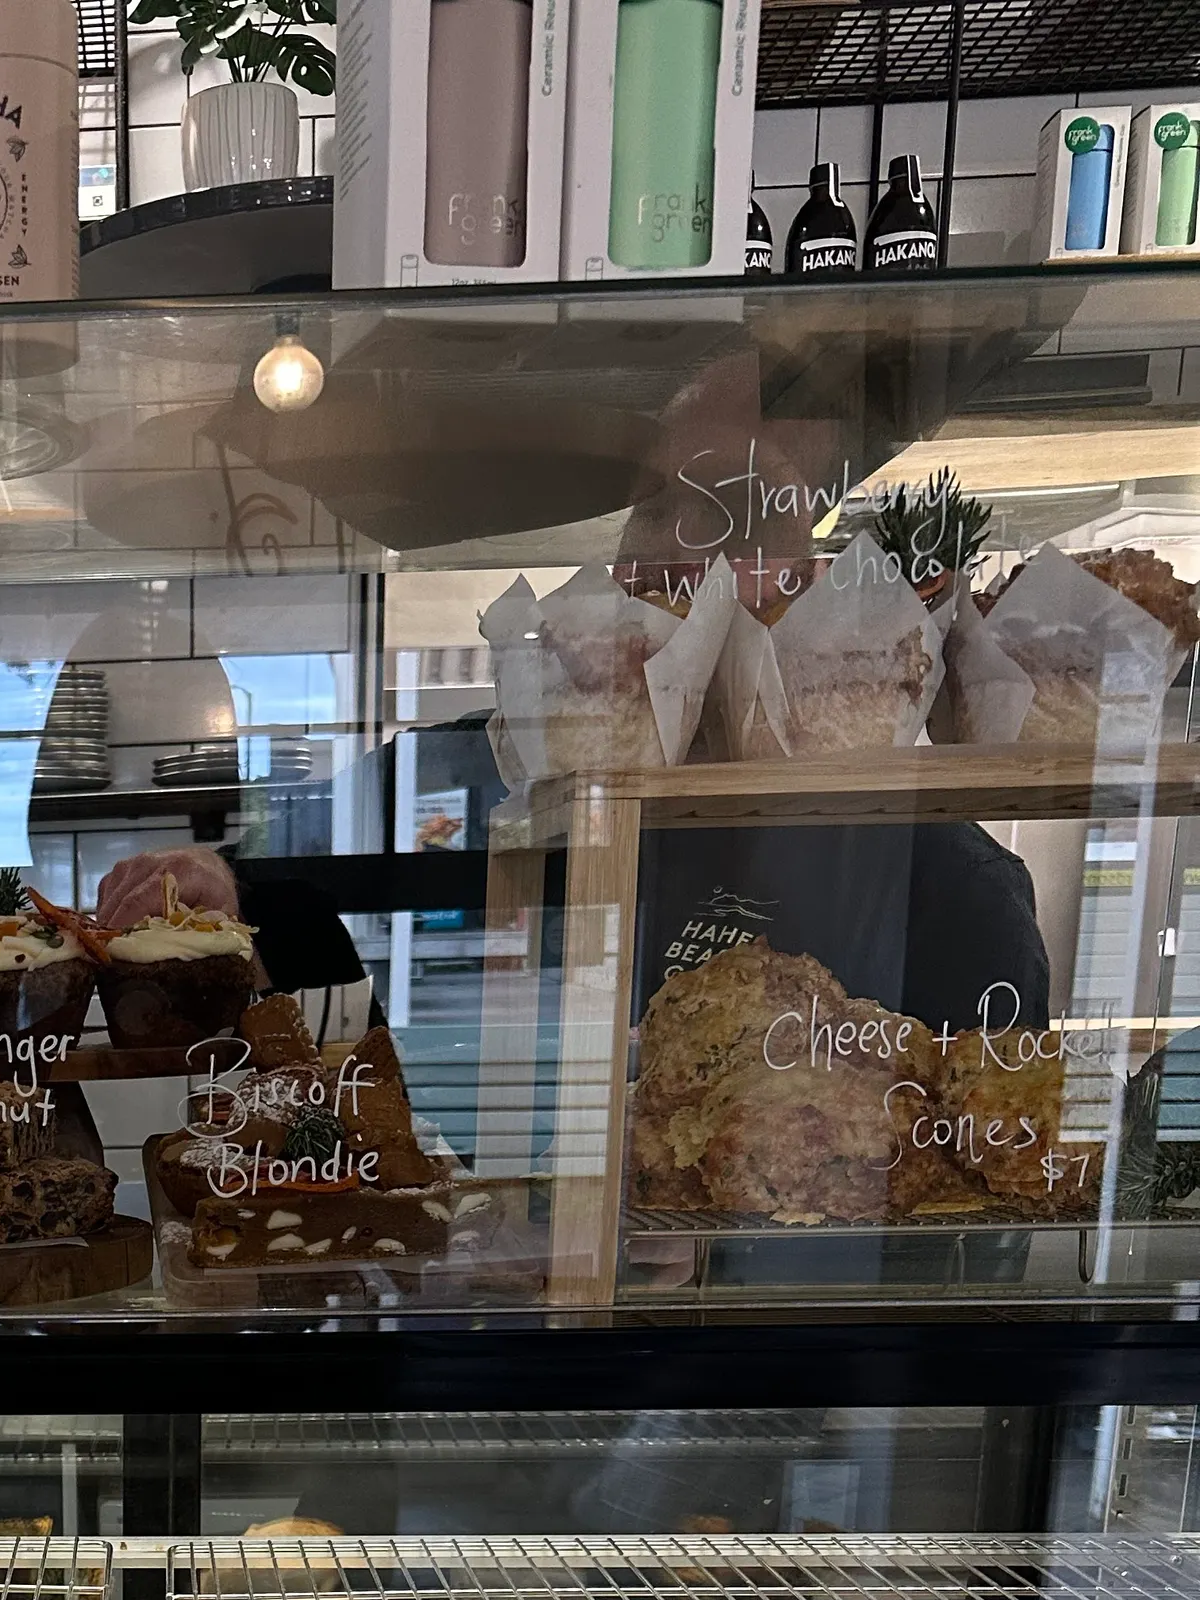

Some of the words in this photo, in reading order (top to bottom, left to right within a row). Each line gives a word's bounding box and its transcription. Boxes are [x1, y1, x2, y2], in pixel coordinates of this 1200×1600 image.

[20, 173, 29, 237] ENERGY
[675, 438, 952, 556] Strawberry
[663, 546, 803, 609] white
[761, 994, 912, 1073] Cheese
[931, 1019, 959, 1057] +
[976, 981, 1129, 1073] Rocket
[176, 1037, 379, 1138] Biscoff
[870, 1081, 1039, 1172] Scones
[205, 1134, 380, 1199] Blondie
[1040, 1148, 1092, 1194] $7
